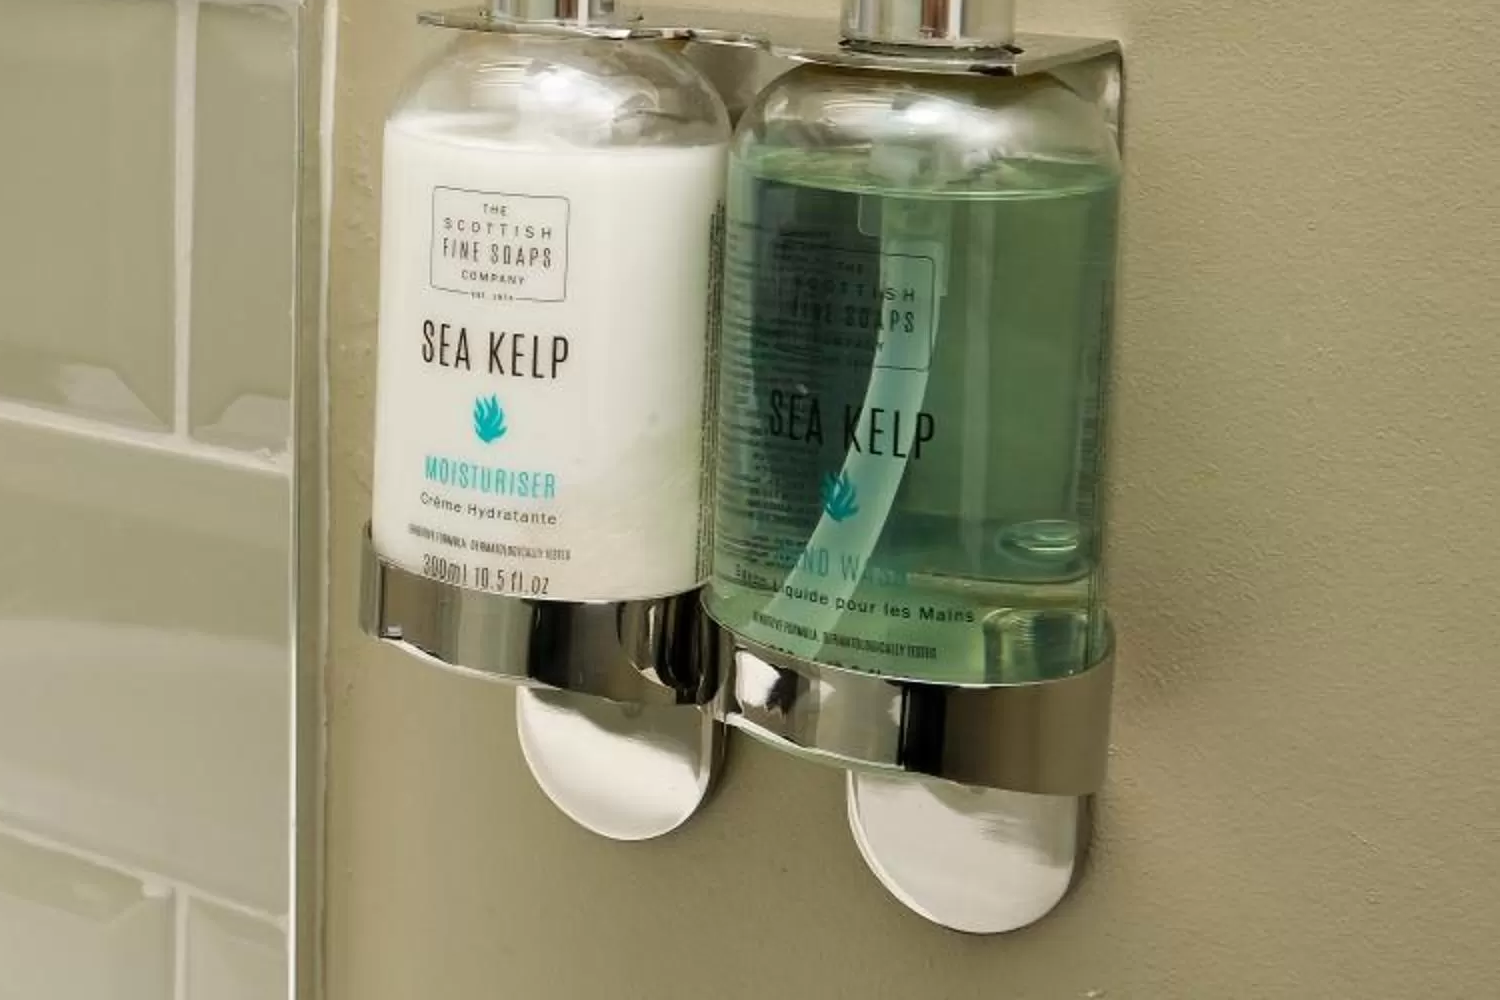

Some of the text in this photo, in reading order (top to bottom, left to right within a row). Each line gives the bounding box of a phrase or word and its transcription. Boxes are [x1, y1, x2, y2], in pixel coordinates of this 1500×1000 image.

[483, 203, 507, 216] THE
[443, 217, 552, 240] SCOTTISH
[443, 237, 552, 268] FINE SOAPS
[461, 270, 525, 285] COMPANY
[422, 319, 569, 379] SEA KELP
[770, 390, 935, 460] SEA KELP
[425, 455, 556, 499] MOISTURISER
[467, 504, 557, 526] Hydratante
[423, 552, 467, 584] 300ml
[474, 567, 505, 593] 10.5
[835, 596, 876, 614] pour
[884, 600, 911, 619] les
[919, 606, 976, 623] Mains
